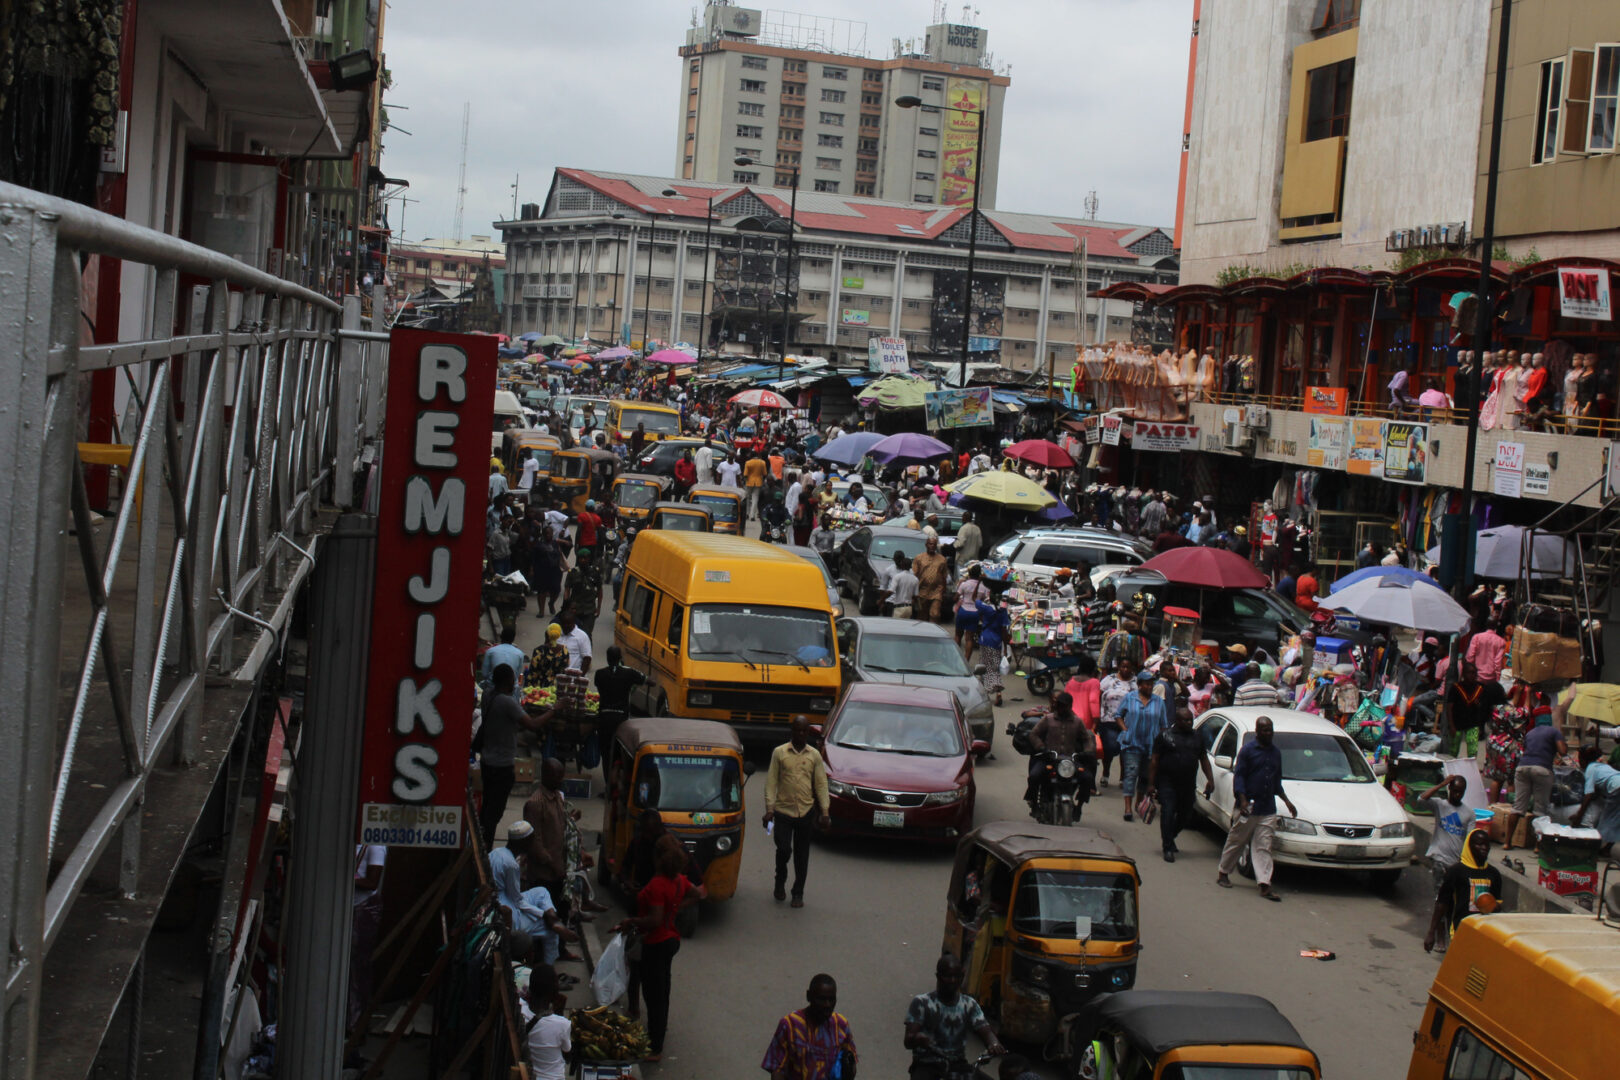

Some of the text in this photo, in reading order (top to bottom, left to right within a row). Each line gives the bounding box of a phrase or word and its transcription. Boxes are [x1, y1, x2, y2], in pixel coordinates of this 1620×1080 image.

[948, 24, 979, 37] LSDPC
[947, 36, 977, 48] HOUSE
[882, 343, 904, 351] TOILET
[883, 354, 906, 363] BATH
[1136, 422, 1200, 438] PATSY
[391, 343, 468, 801] REMJIKS
[367, 805, 457, 825] Exclusive
[363, 828, 458, 846] 08033014480
